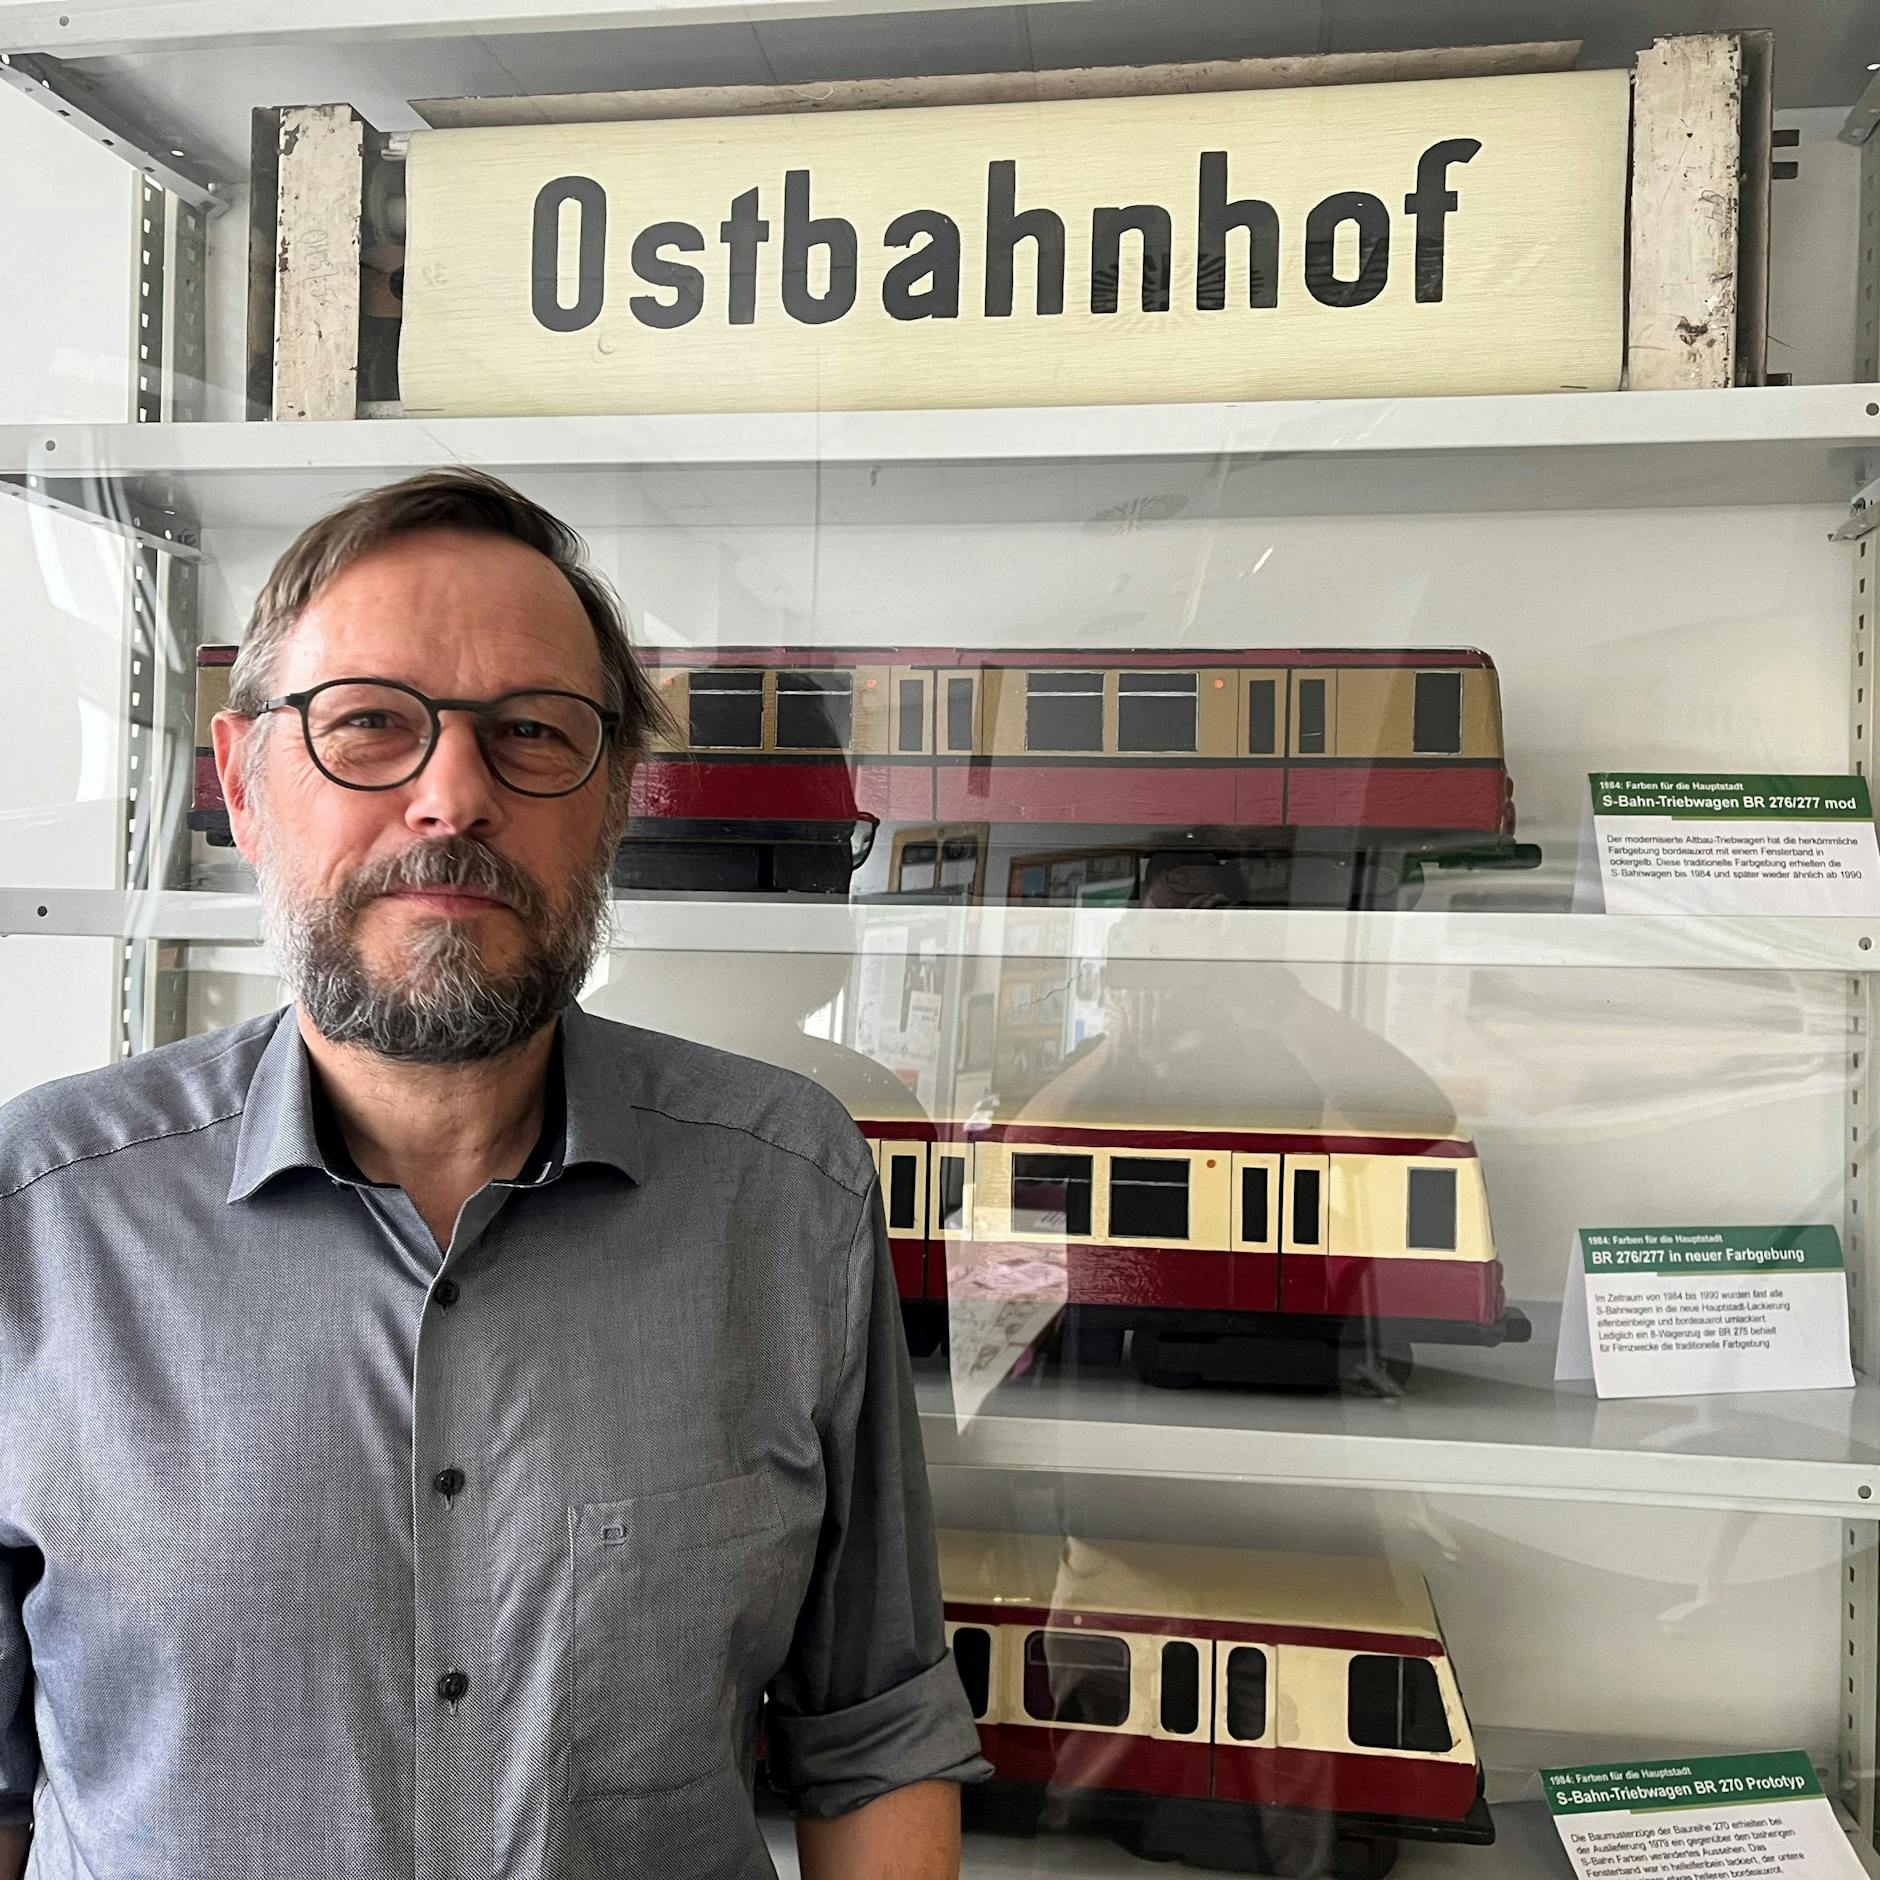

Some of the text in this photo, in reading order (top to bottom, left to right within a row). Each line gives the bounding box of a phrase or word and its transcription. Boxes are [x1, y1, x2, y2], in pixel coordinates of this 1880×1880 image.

[532, 138, 1482, 332] Ostbahnhof
[1600, 781, 1744, 791] 1984: Farben für die Hauptstadt
[1602, 795, 1856, 810] S-Bahn-Triebwagen BR 276/277 mod
[1607, 835, 1858, 845] Der modernisierte Altbau-Triebwagen hat die herkömmliche
[1608, 846, 1659, 856] Farbgebung
[1662, 847, 1713, 855] bordeauxrot
[1716, 847, 1729, 855] mit
[1761, 847, 1813, 856] Fensterband
[1816, 848, 1824, 856] in
[1656, 858, 1681, 866] Diese
[1684, 858, 1732, 867] traditionelle
[1735, 858, 1787, 869] Farbgebung
[1789, 859, 1826, 868] erhielten
[1829, 860, 1841, 868] die
[1611, 869, 1672, 879] S-Bahnwagen
[1675, 869, 1687, 878] bis
[1691, 870, 1711, 878] 1984
[1714, 870, 1730, 878] und
[1733, 870, 1762, 879] später
[1762, 871, 1790, 879] wieder
[1793, 871, 1824, 879] ähnlich
[1826, 871, 1838, 879] ab
[1588, 1234, 1724, 1245] 1984: Farben für die Hauptstadt
[1592, 1247, 1805, 1264] BR 276/277 in neuer Farbgebung
[1595, 1294, 1605, 1303] Im
[1608, 1293, 1643, 1302] Zeitraum
[1664, 1292, 1682, 1301] 1984
[1685, 1292, 1697, 1300] bis
[1700, 1291, 1719, 1300] 1990
[1721, 1291, 1751, 1299] wurden
[1753, 1289, 1767, 1298] fast
[1770, 1289, 1784, 1298] alle
[1596, 1305, 1653, 1315] S-Bahnwagen
[1656, 1305, 1663, 1313] in
[1665, 1305, 1678, 1313] die
[1702, 1302, 1791, 1312] Hauptstadt-Lackierung
[1597, 1318, 1656, 1329] elfenbeinbeige
[1658, 1317, 1673, 1326] und
[1675, 1316, 1722, 1325] bordeauxrot
[1599, 1331, 1634, 1341] Lediglich
[1636, 1330, 1648, 1339] ein
[1703, 1328, 1716, 1336] der
[1719, 1328, 1731, 1336] BR
[1734, 1327, 1748, 1336] 275
[1750, 1326, 1777, 1335] behielt
[1600, 1340, 1770, 1352] für Filmzwecke die traditionelle Farbgebung
[1576, 1773, 1608, 1783] Farben
[1609, 1771, 1623, 1780] für
[1625, 1770, 1640, 1780] die
[1641, 1766, 1692, 1779] Hauptstadt
[1556, 1775, 1805, 1805] S-Bahn-Triebwagen BR 270 Prototyp
[1571, 1817, 1782, 1843] Die Baumusterzüge der Baureihe 270 erhielten bei
[1576, 1829, 1796, 1854] der Auslieferung 1979 ein gegenüber den bisherigen
[1580, 1857, 1615, 1867] S-Bahn
[1616, 1854, 1648, 1864] Farben
[1747, 1843, 1767, 1852] Das
[1586, 1866, 1642, 1878] Fensterband
[1643, 1864, 1659, 1873] war
[1661, 1863, 1671, 1872] in
[1761, 1854, 1775, 1863] der
[1777, 1852, 1804, 1861] untere
